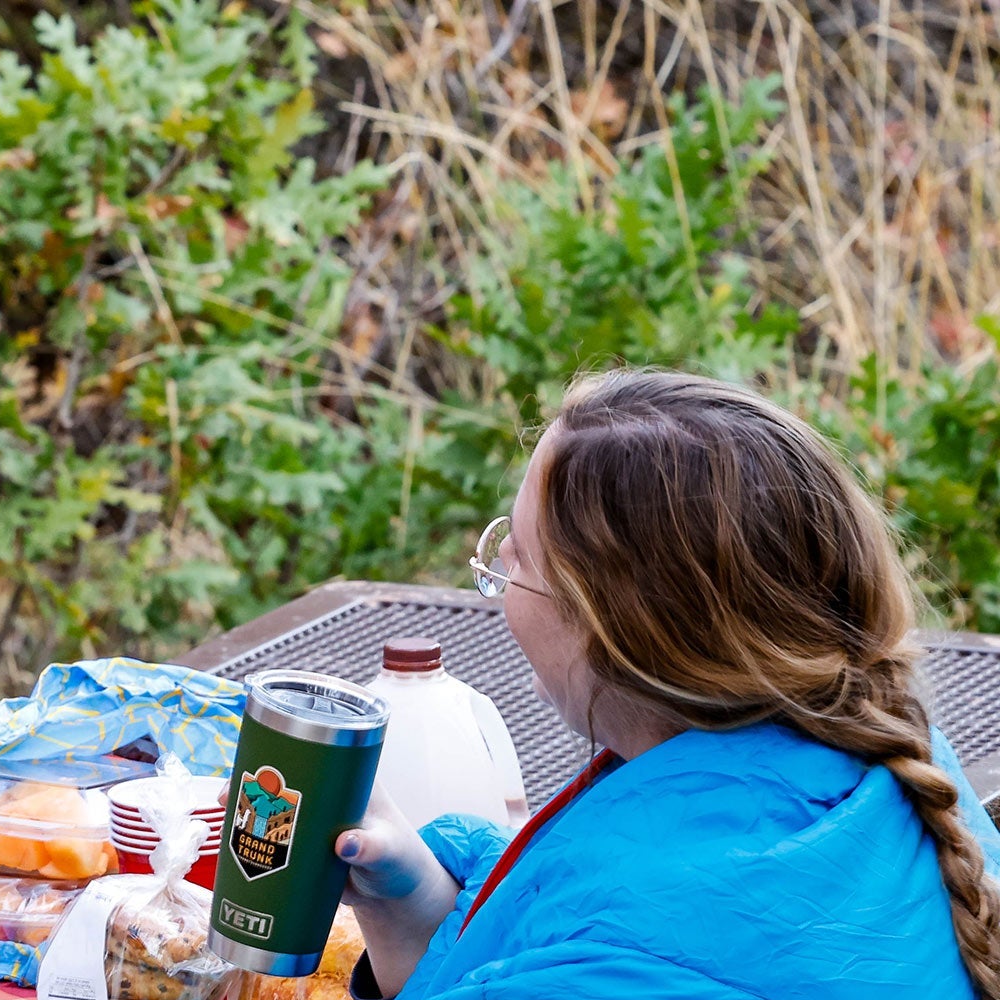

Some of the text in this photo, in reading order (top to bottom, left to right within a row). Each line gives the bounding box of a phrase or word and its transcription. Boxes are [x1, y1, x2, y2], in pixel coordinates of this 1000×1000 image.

[238, 833, 277, 854] GRAND
[237, 844, 274, 866] TRUNK
[224, 903, 266, 934] YETI
